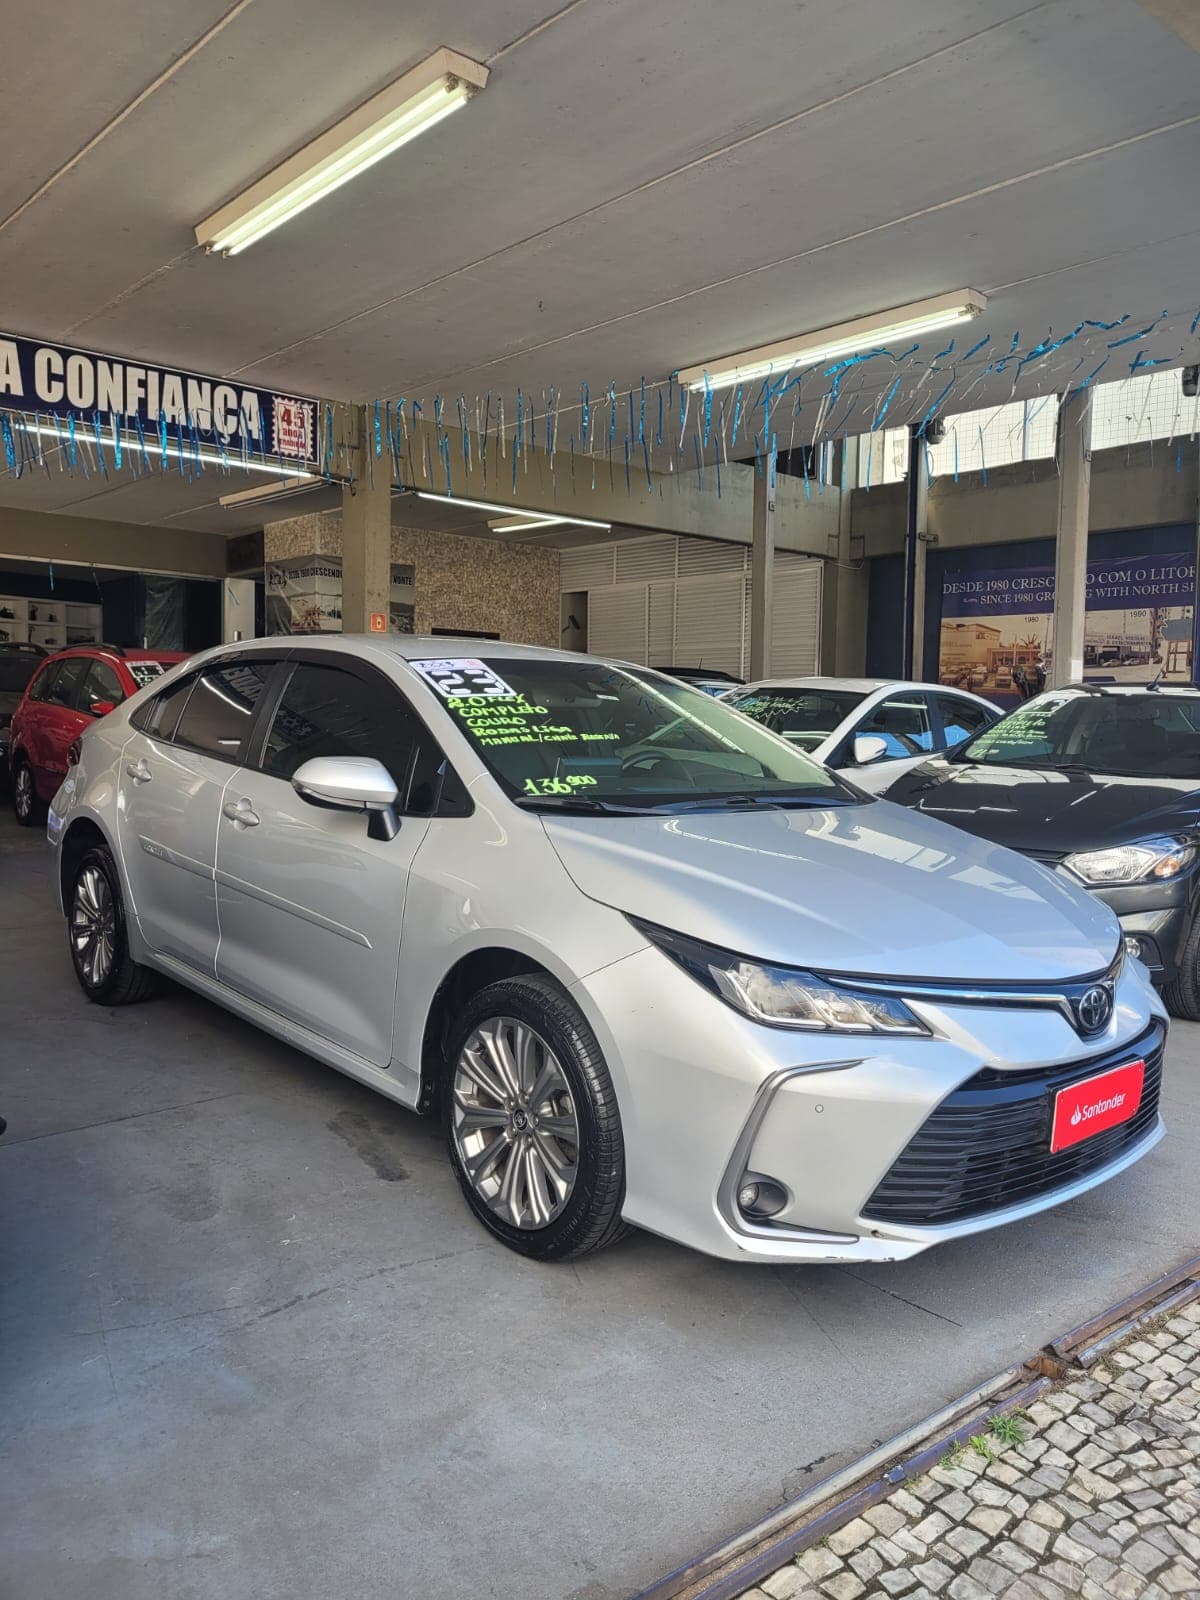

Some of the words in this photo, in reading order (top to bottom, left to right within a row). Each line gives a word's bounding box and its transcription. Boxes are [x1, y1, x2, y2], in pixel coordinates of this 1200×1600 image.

[0, 339, 23, 396] A
[35, 348, 262, 444] CONFIANÇA
[281, 408, 305, 429] 45
[944, 581, 984, 595] DESDE
[987, 579, 1009, 592] 1980
[1011, 573, 1095, 590] CRESCO
[1099, 570, 1131, 583] COM
[1135, 569, 1147, 581] O
[980, 594, 1012, 605] SINCE
[1014, 592, 1034, 603] 1980
[1096, 586, 1129, 599] WITH
[1132, 583, 1179, 597] NORTH
[1024, 616, 1039, 624] 1980
[1130, 610, 1147, 618] 1980
[430, 669, 505, 694] 23
[487, 693, 525, 704] FLEX
[459, 703, 548, 717] COMPLETO
[466, 717, 527, 727] COURO
[472, 728, 530, 736] RODAS
[1081, 1094, 1126, 1120] Santander
